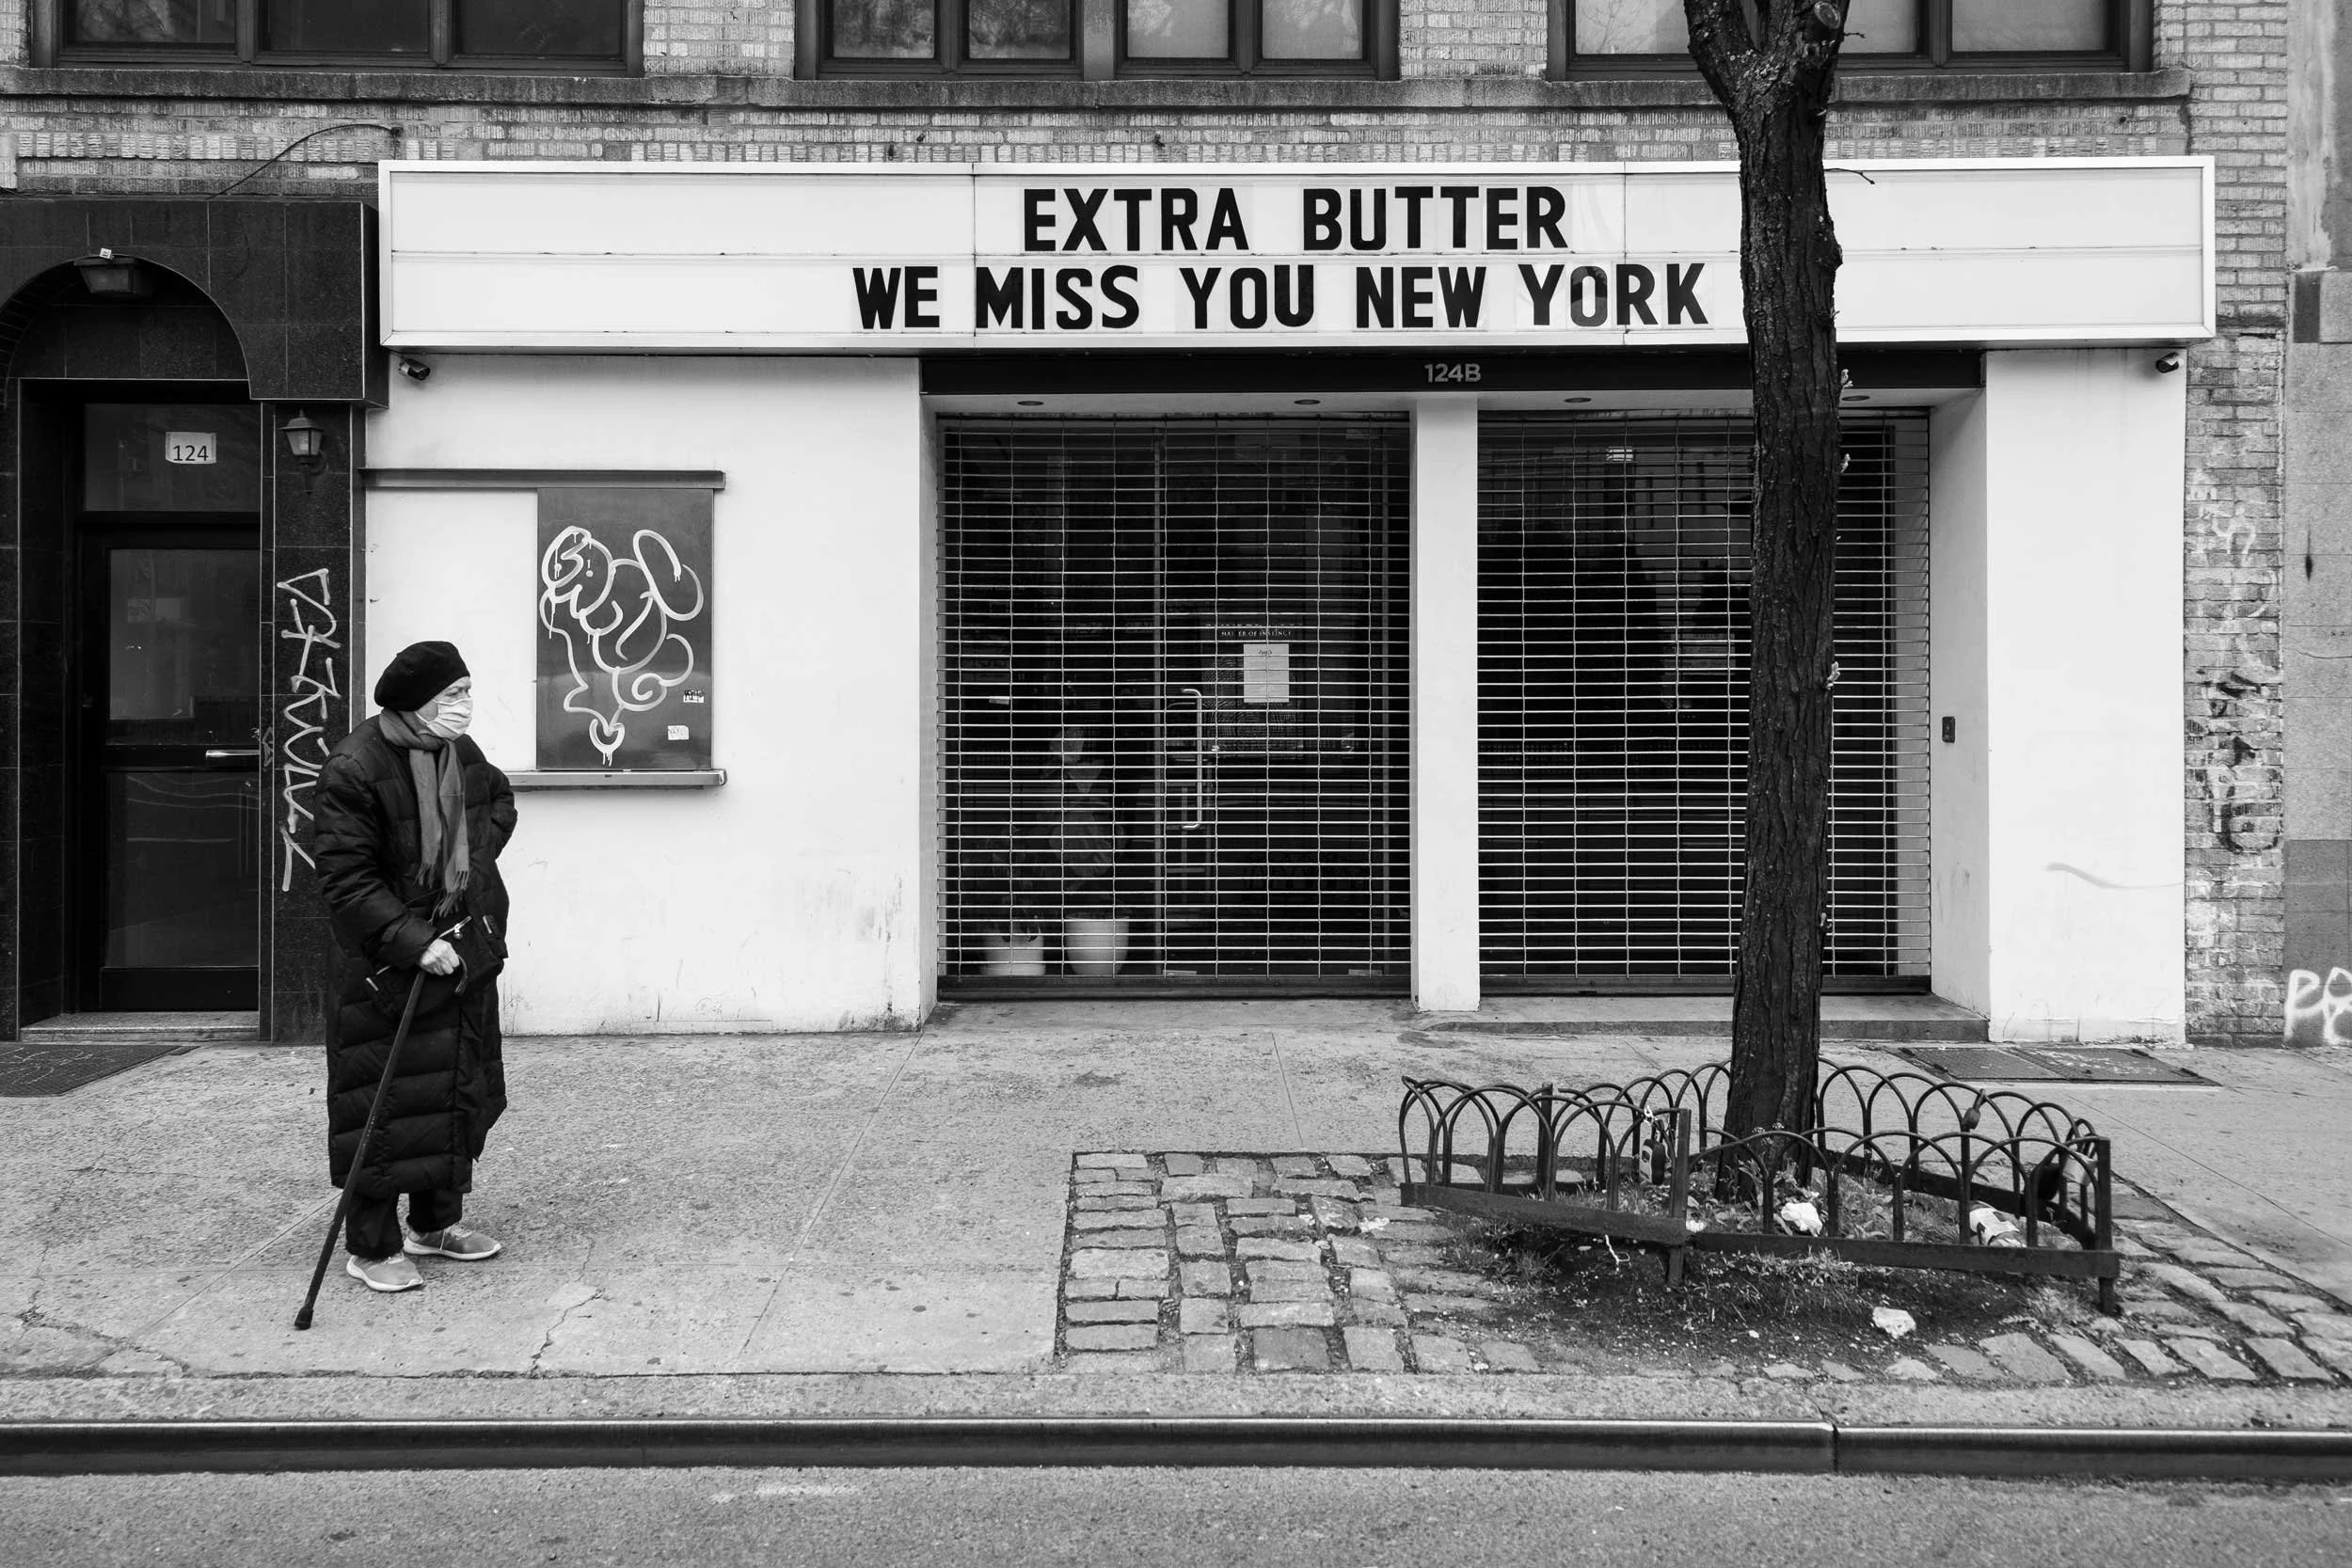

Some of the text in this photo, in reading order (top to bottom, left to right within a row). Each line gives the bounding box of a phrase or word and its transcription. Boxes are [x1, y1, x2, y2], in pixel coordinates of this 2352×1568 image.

[1024, 185, 1568, 252] EXTRA BUTTER
[852, 262, 1708, 330] WE MISS YOU NEW YORK
[1424, 363, 1482, 383] 124B
[173, 444, 209, 462] 124
